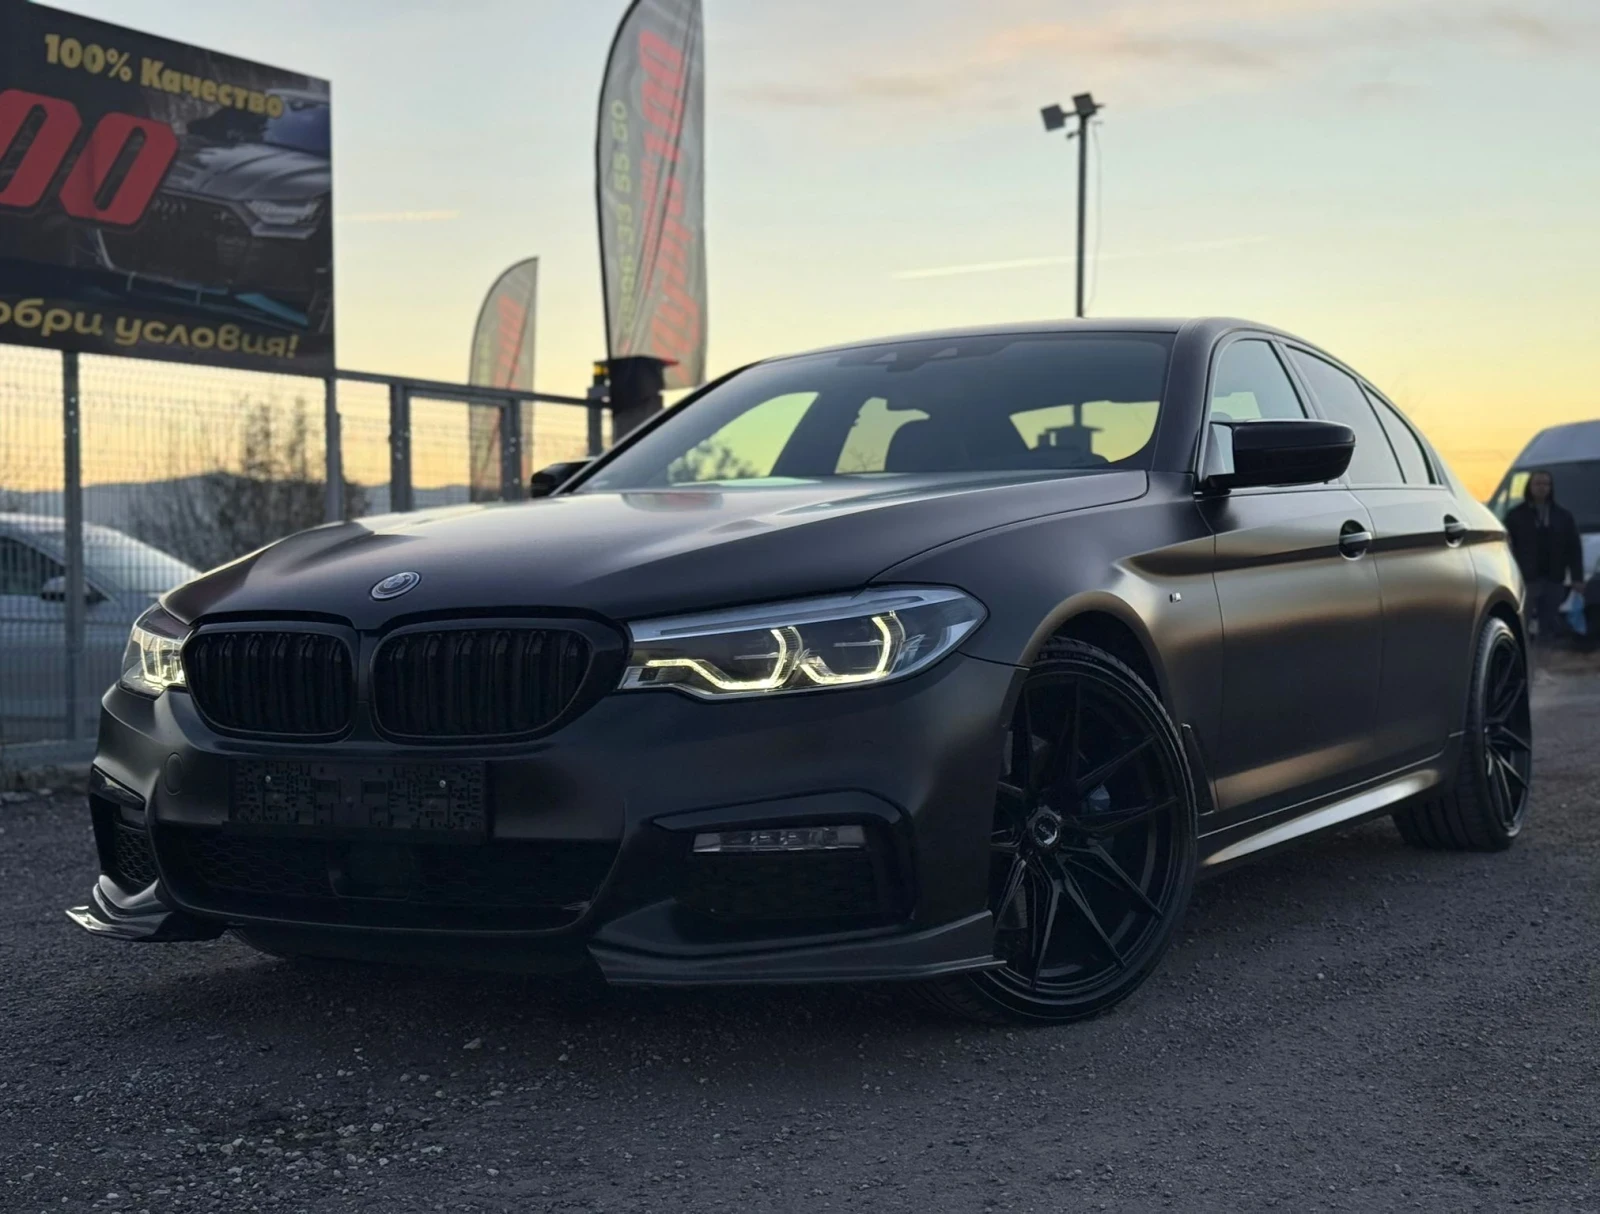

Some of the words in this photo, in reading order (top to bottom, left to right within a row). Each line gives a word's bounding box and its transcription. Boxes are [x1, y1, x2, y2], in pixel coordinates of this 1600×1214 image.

[45, 34, 132, 80] 100%
[141, 58, 284, 117] Качество
[115, 319, 299, 358] условия!
